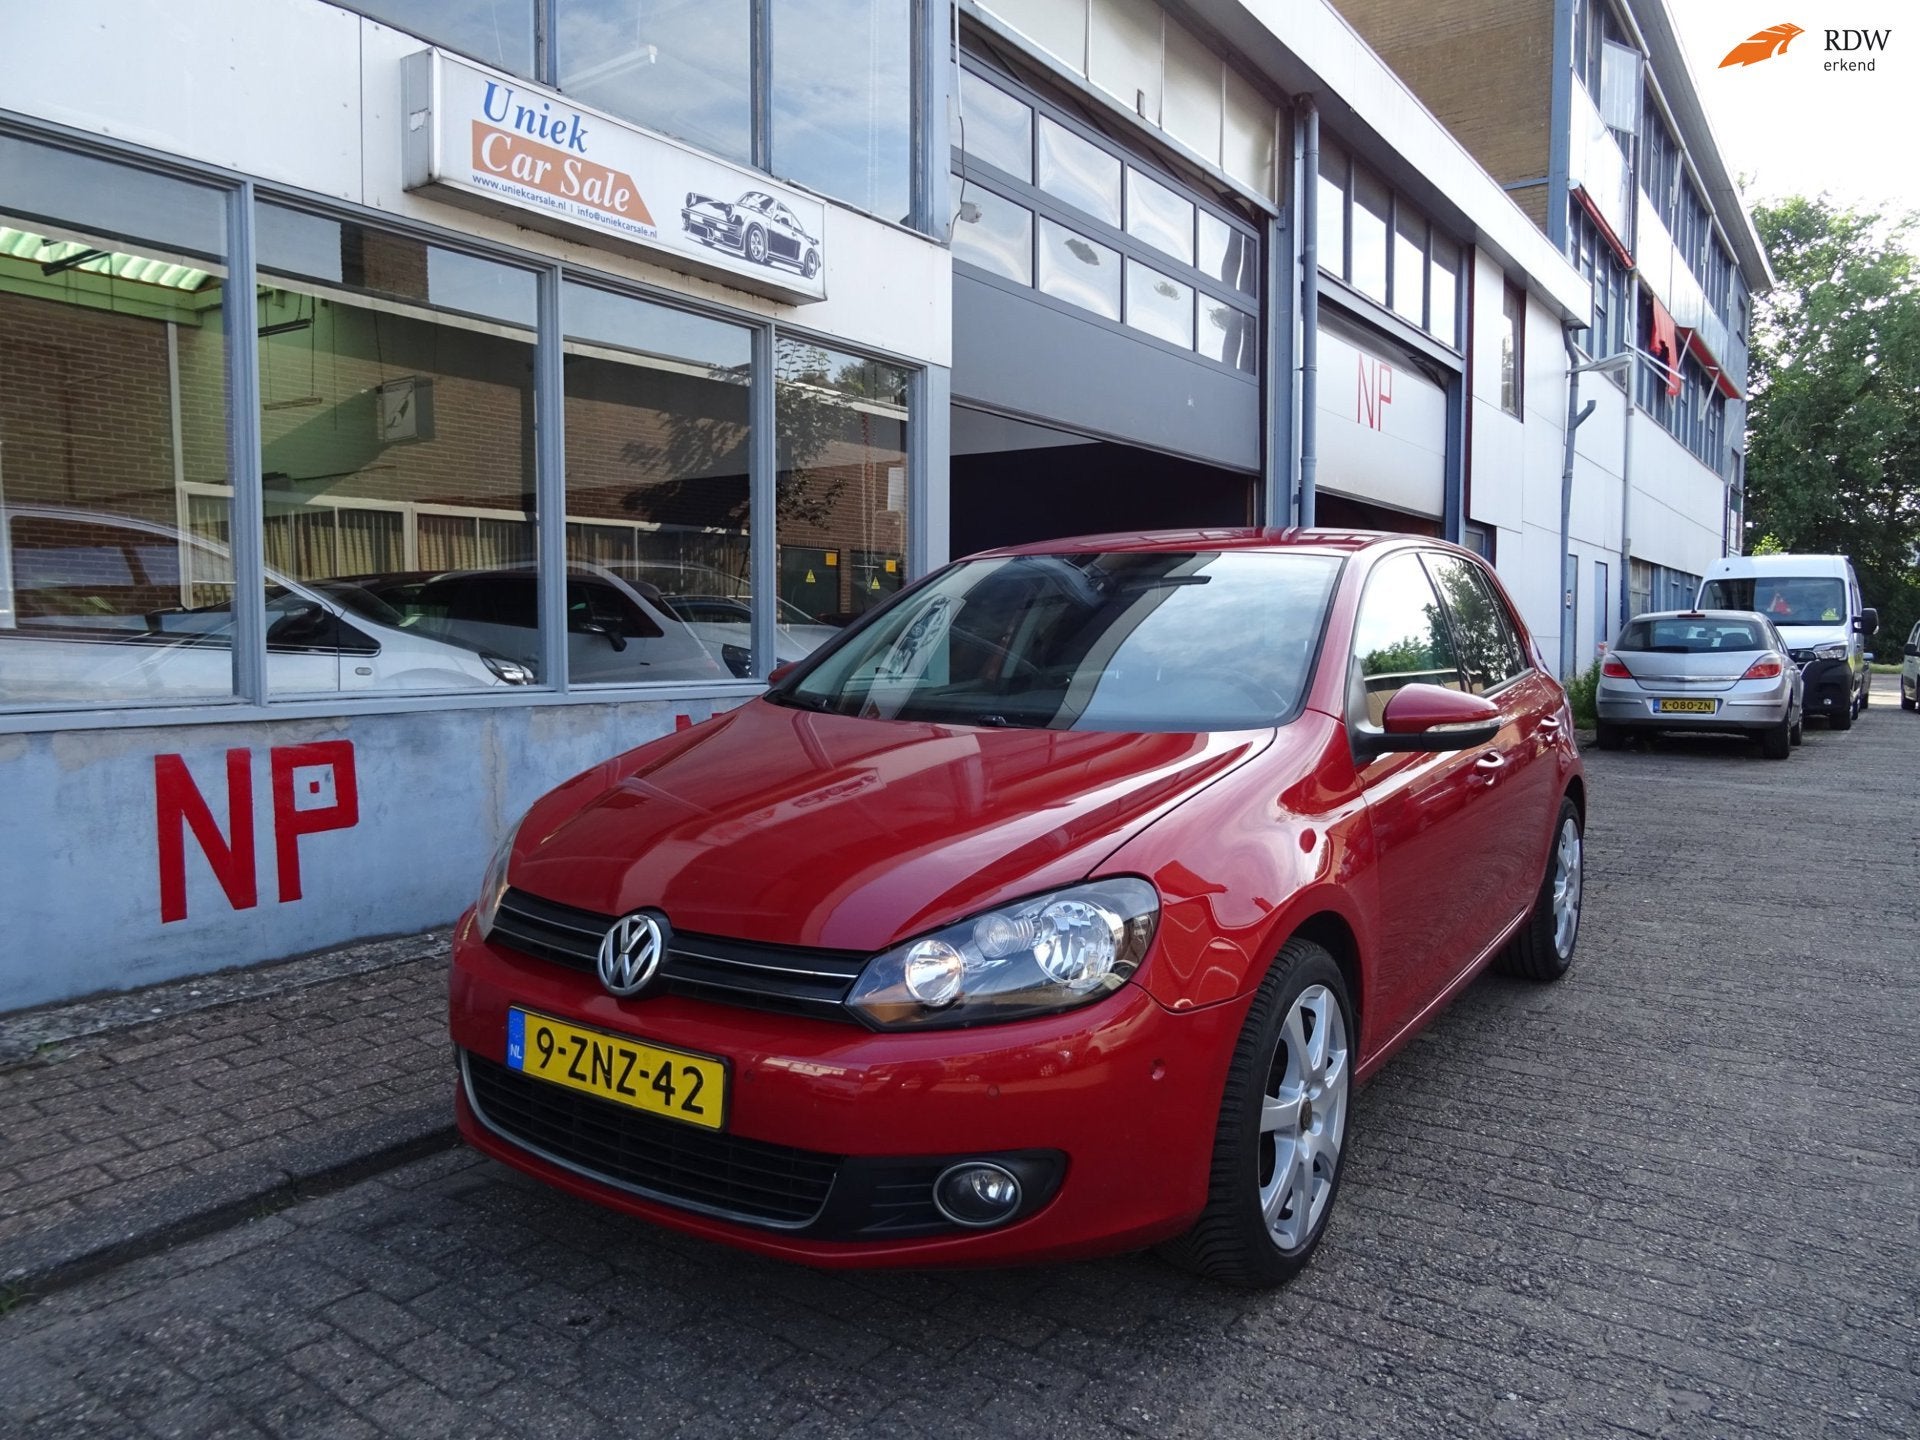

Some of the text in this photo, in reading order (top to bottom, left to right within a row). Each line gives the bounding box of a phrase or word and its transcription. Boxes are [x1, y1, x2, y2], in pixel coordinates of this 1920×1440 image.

[483, 80, 588, 153] Uniek
[472, 175, 567, 211] www.uniekcarsale.nl
[577, 206, 657, 239] info@uniekcarsale.nl
[481, 132, 630, 212] Car Sale
[1357, 353, 1392, 432] NP
[1661, 701, 1711, 710] K-080-ZN
[154, 739, 359, 924] NP
[510, 1027, 705, 1115] NL 9-ZNZ-42
